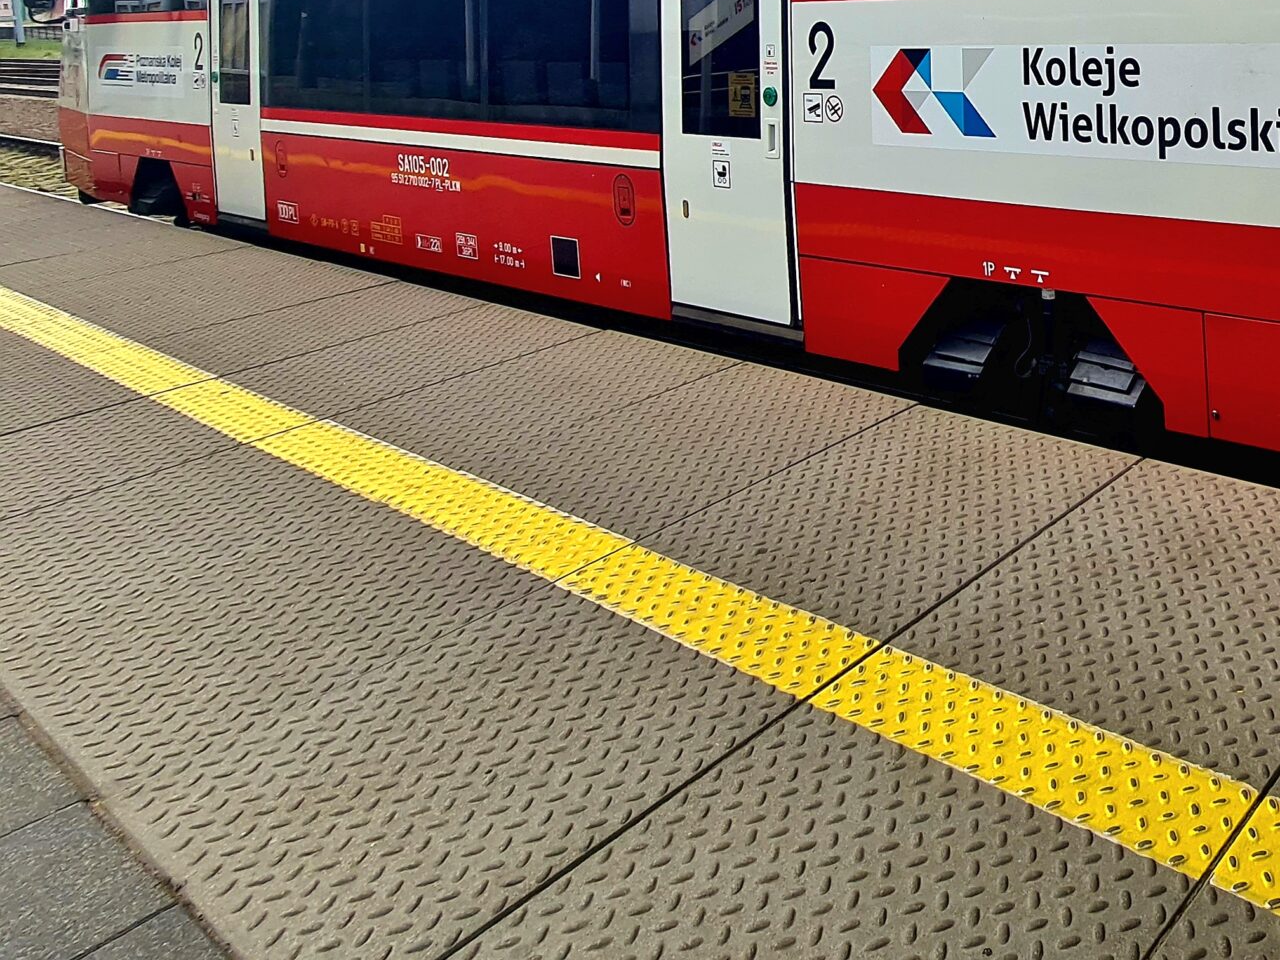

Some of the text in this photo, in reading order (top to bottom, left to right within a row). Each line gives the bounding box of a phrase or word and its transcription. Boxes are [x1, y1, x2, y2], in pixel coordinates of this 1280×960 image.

[194, 32, 203, 70] 2
[809, 21, 836, 89] 2
[1022, 46, 1141, 96] Koleje
[397, 153, 450, 178] SA105-002
[983, 261, 995, 277] 1P
